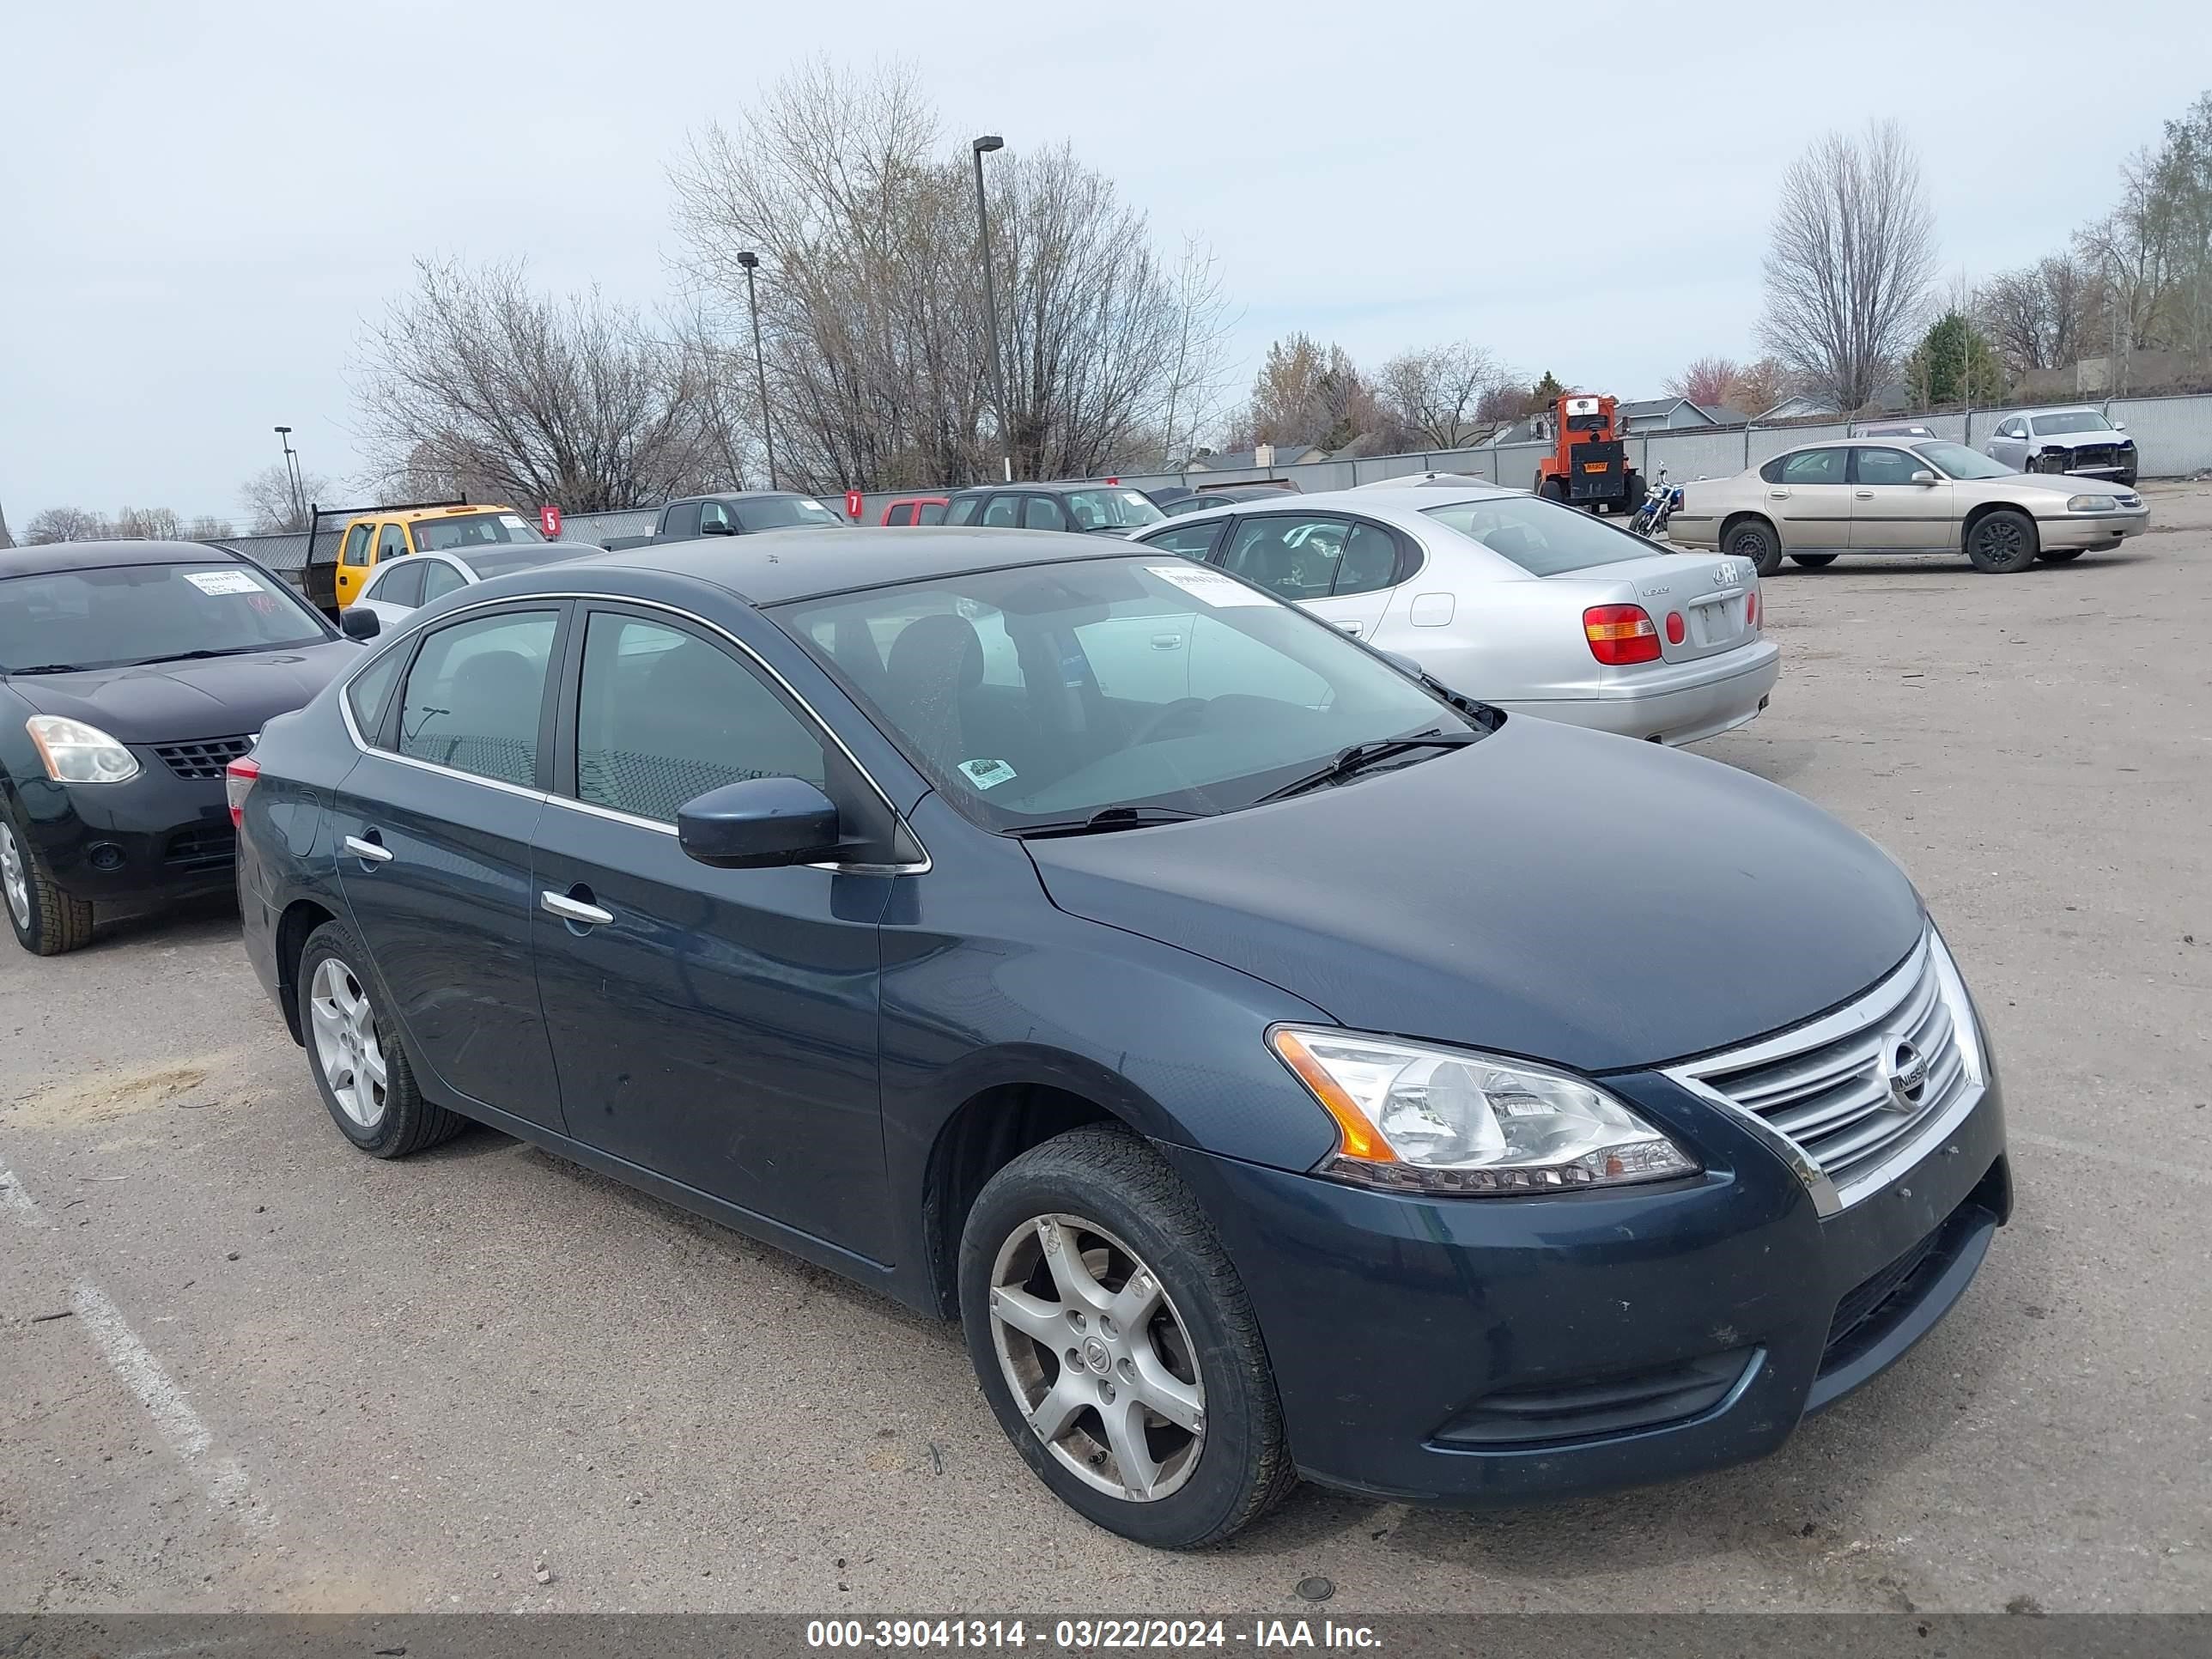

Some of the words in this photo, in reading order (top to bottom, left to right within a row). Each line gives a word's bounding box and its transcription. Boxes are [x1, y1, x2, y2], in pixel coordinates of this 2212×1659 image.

[850, 495, 858, 513] 7
[546, 512, 556, 531] 5
[1722, 562, 1739, 583] RH
